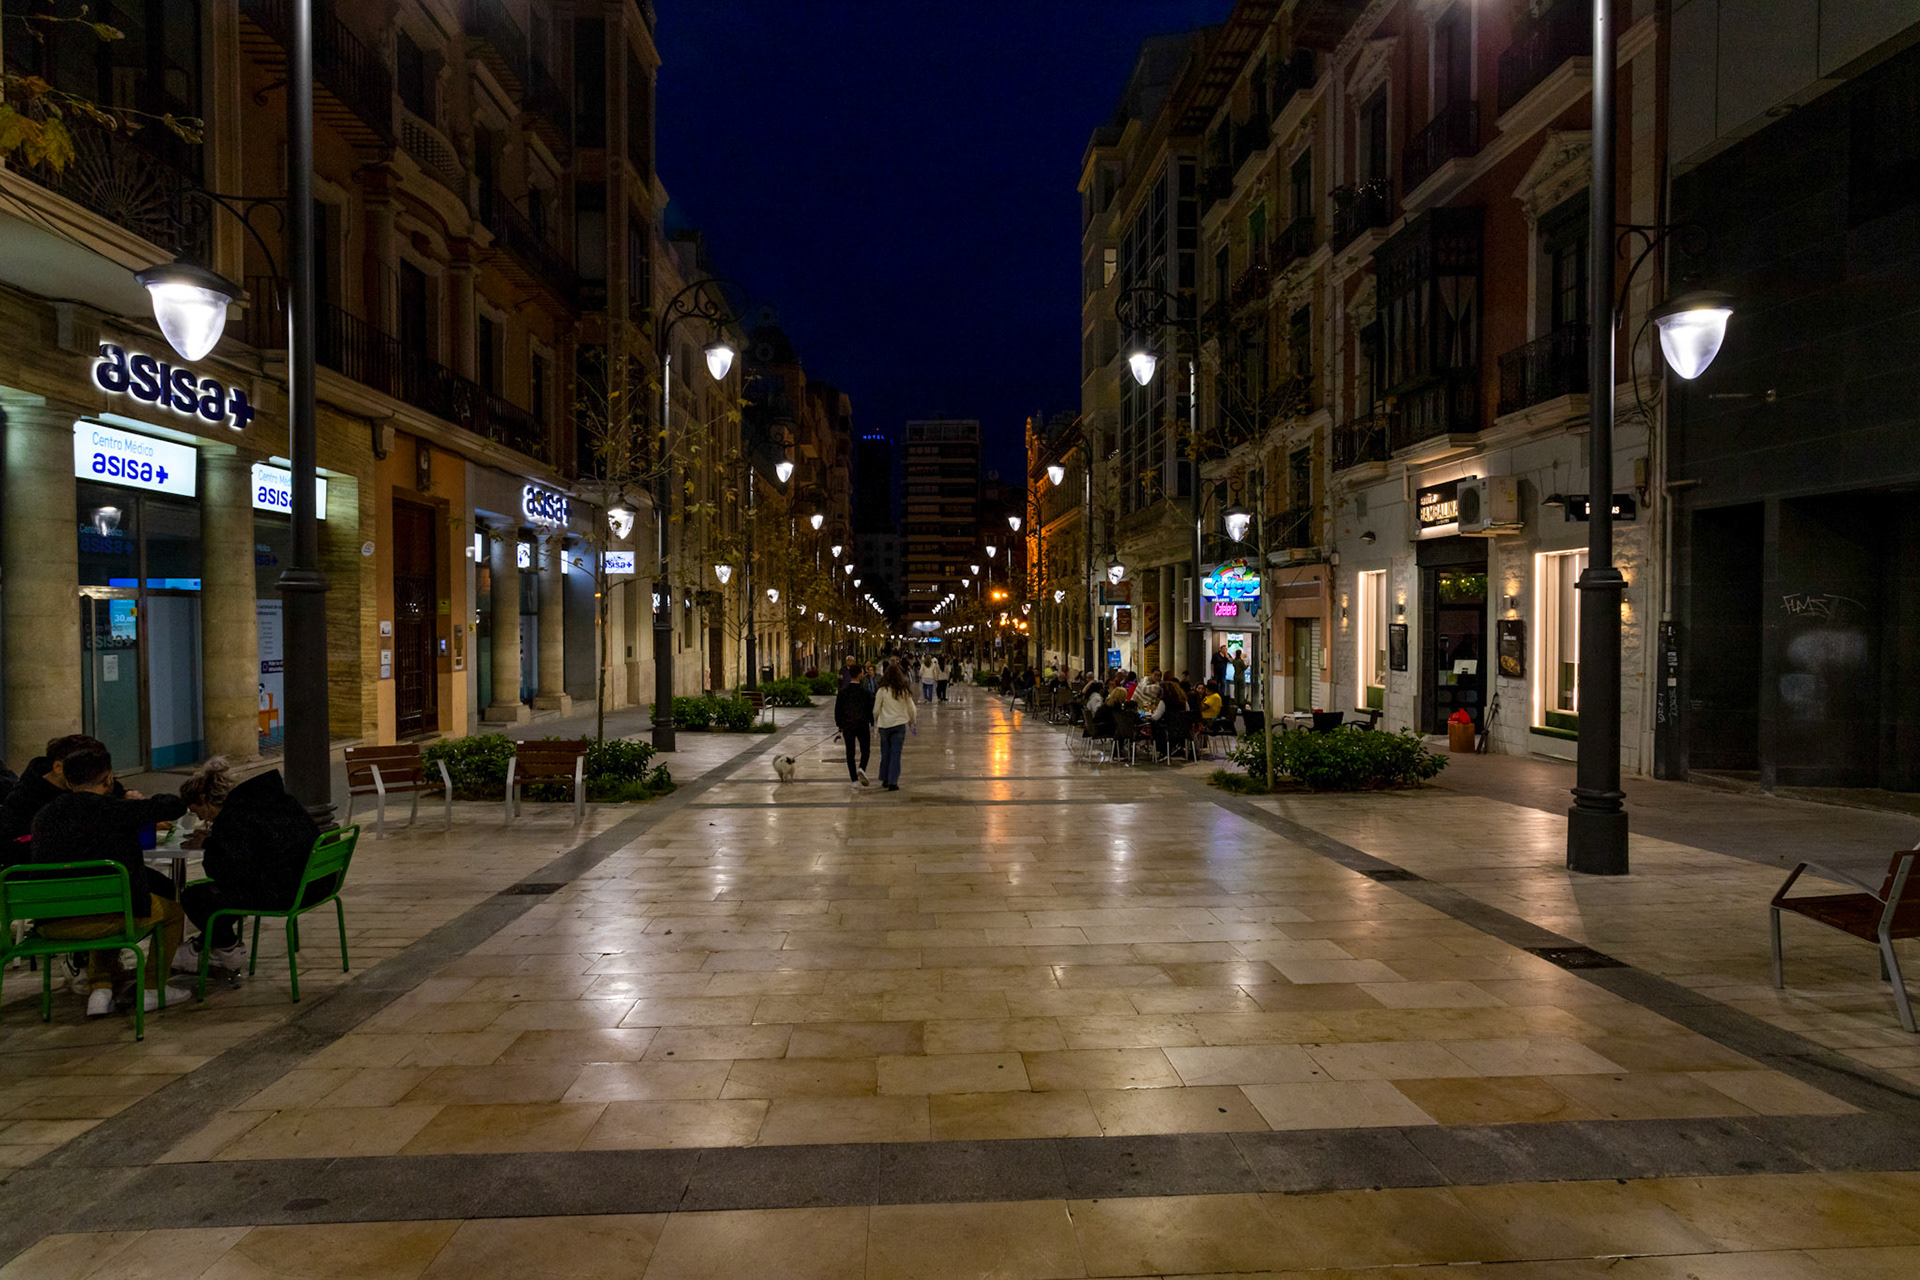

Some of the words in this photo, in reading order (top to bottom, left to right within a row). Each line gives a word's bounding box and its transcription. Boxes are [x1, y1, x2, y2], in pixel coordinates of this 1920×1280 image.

[92, 431, 123, 451] Centro
[124, 437, 154, 457] Médico
[258, 469, 278, 484] Centro
